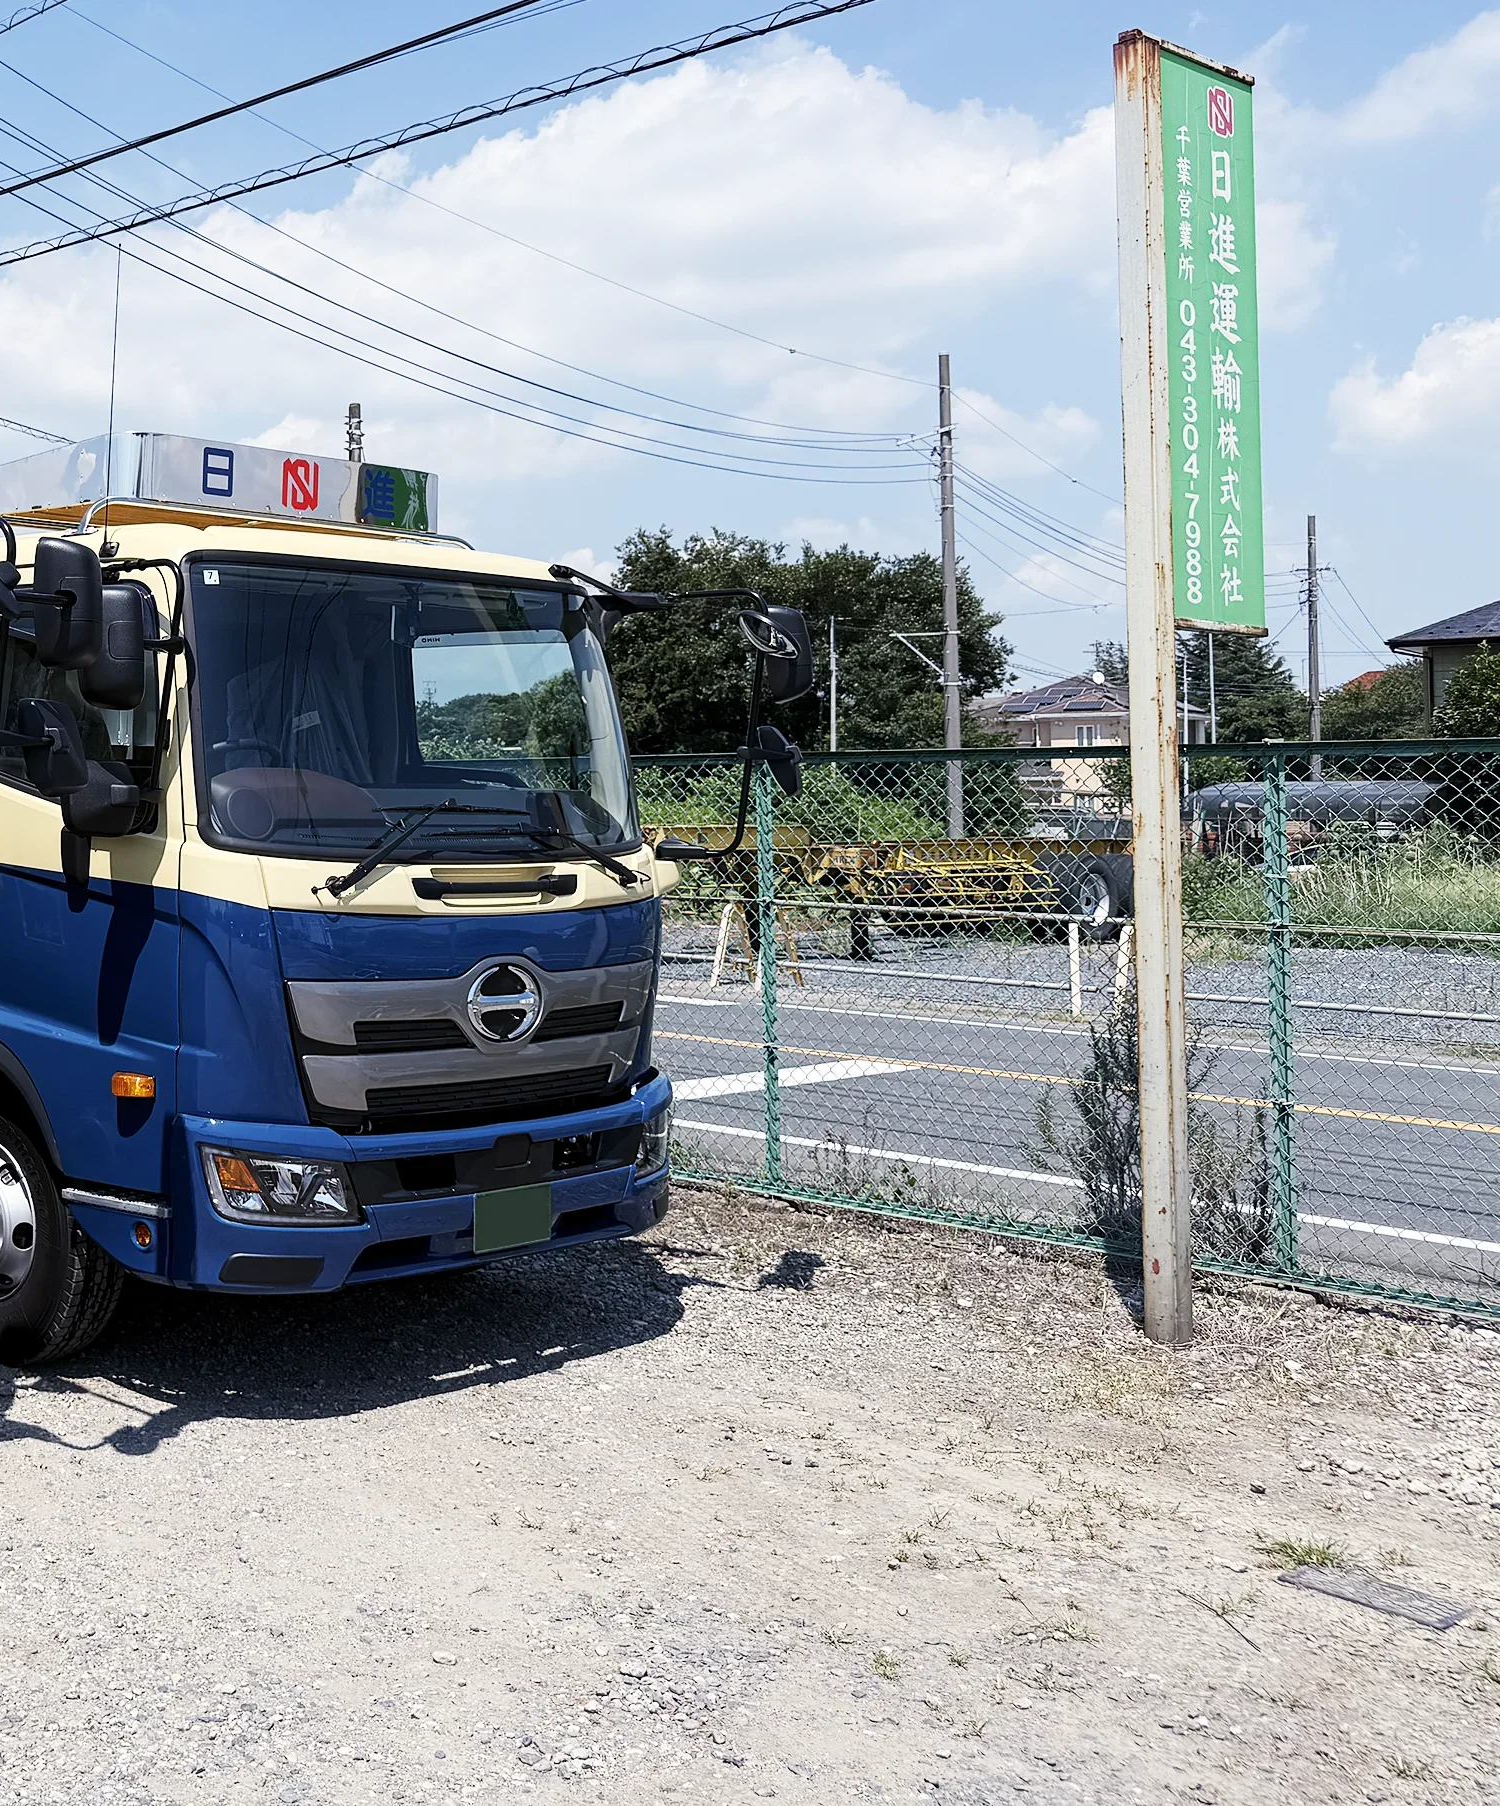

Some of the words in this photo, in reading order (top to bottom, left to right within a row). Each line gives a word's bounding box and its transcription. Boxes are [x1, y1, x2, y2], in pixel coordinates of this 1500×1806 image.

[1175, 125, 1196, 285] 千葉営業所
[202, 446, 234, 498] 日
[363, 468, 396, 519] 進
[1179, 299, 1203, 605] 043-304-7988
[1208, 149, 1244, 607] 日進運輸株式会社
